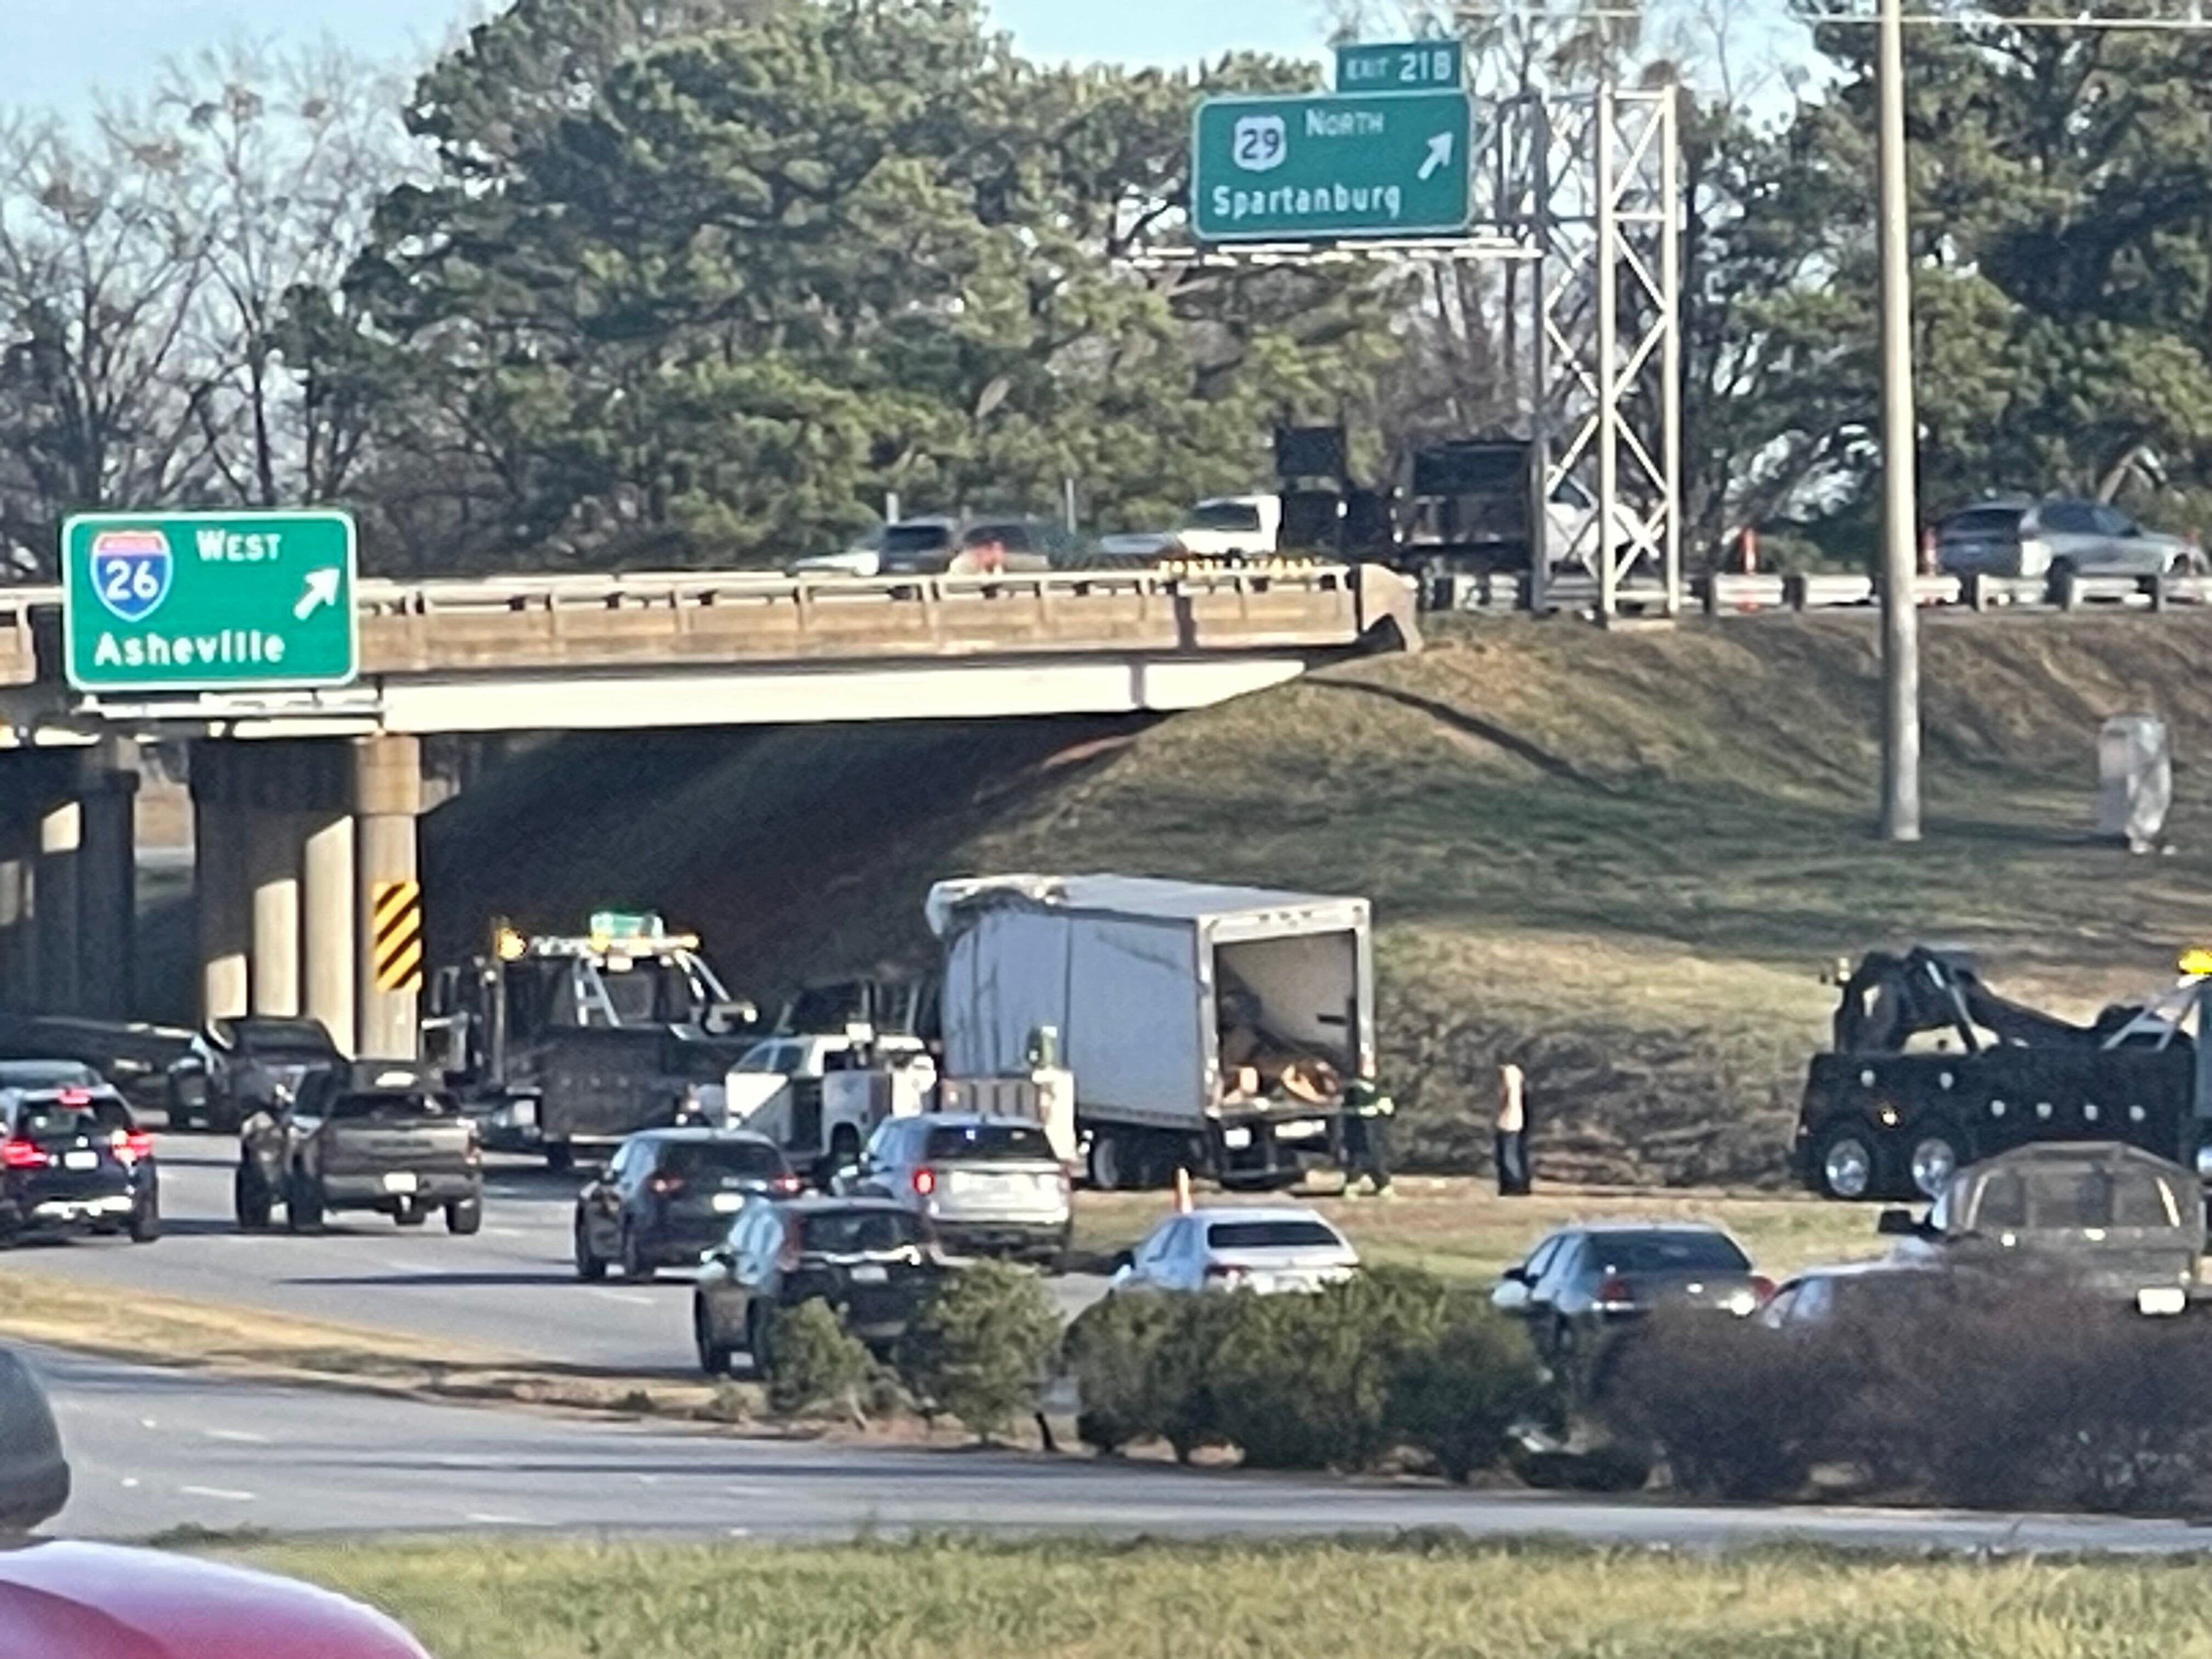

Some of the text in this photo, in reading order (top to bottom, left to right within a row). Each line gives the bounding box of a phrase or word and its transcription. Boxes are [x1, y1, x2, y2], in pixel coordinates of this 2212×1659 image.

[1399, 51, 1452, 81] 21B
[1305, 109, 1384, 136] NORTH
[1241, 128, 1280, 160] 29
[1212, 182, 1400, 219] Spartanburg
[196, 529, 282, 561] WEST
[106, 560, 160, 601] 26
[94, 629, 286, 667] Asheville
